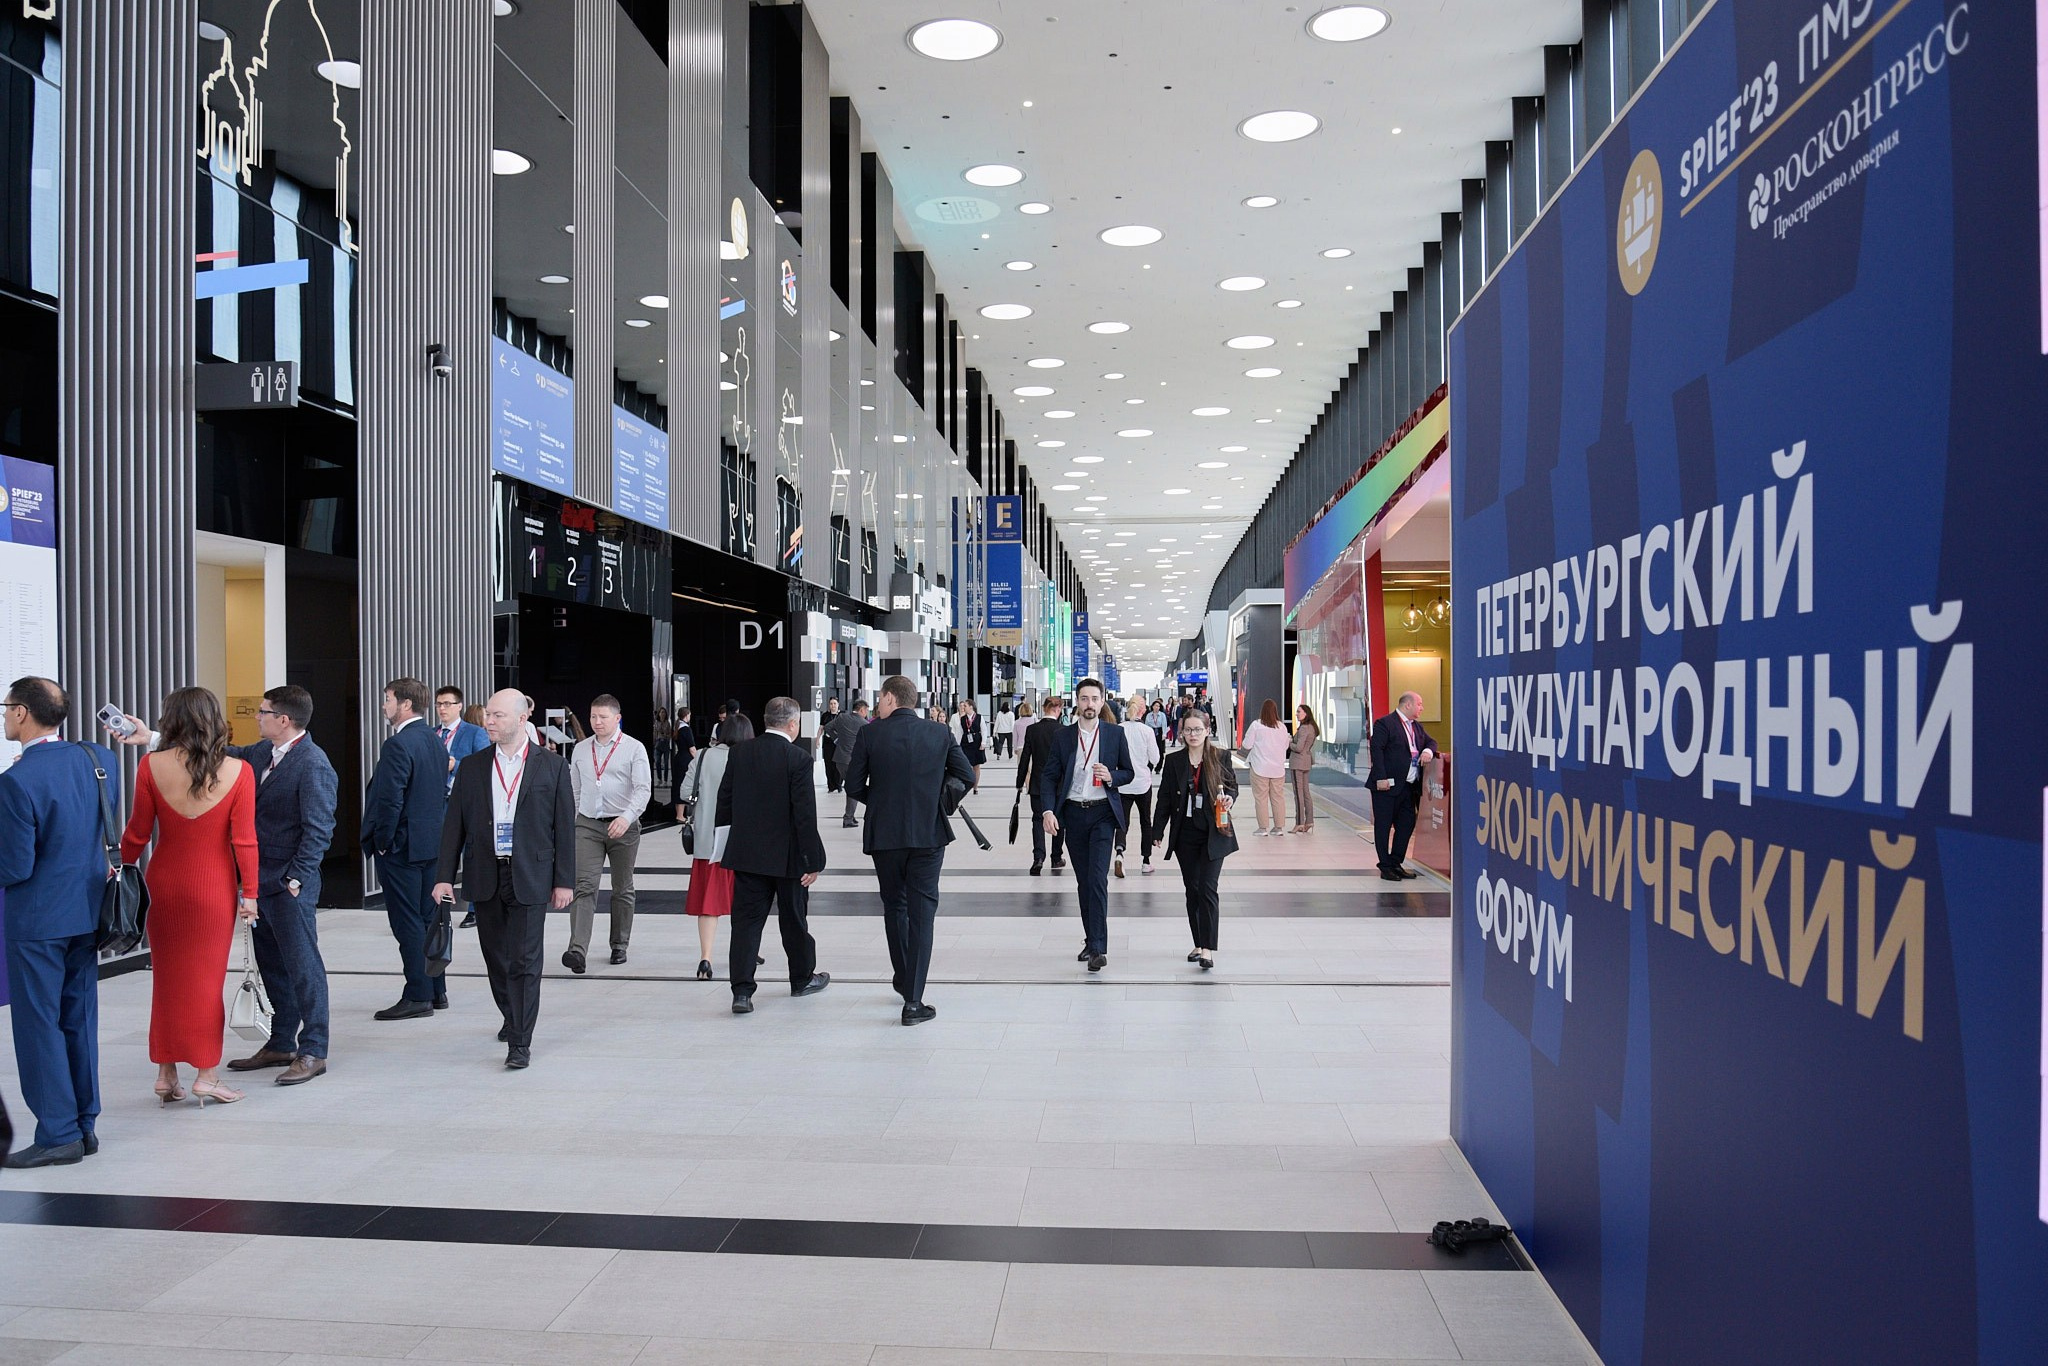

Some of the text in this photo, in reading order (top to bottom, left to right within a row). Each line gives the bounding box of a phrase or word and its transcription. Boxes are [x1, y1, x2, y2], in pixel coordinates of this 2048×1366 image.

[1680, 61, 1778, 198] SPIEF'23
[1773, 2, 1969, 206] РОСКОНГРЕСС
[1773, 129, 1900, 240] Пространство доверия
[12, 488, 42, 501] SPIEF'23
[997, 503, 1012, 528] E
[529, 548, 536, 578] 1
[568, 557, 576, 586] 2
[605, 566, 613, 594] 3
[1476, 440, 1813, 658] ПЕТЕРБУРГСКИЙ
[740, 620, 783, 650] D1
[1076, 614, 1085, 628] F
[1477, 600, 1973, 817] МЕЖДУНАРОДНЫЙ
[1476, 775, 1926, 1042] ЭКОНОМИЧЕСКИЙ
[1476, 868, 1573, 1003] ФОРУМ
